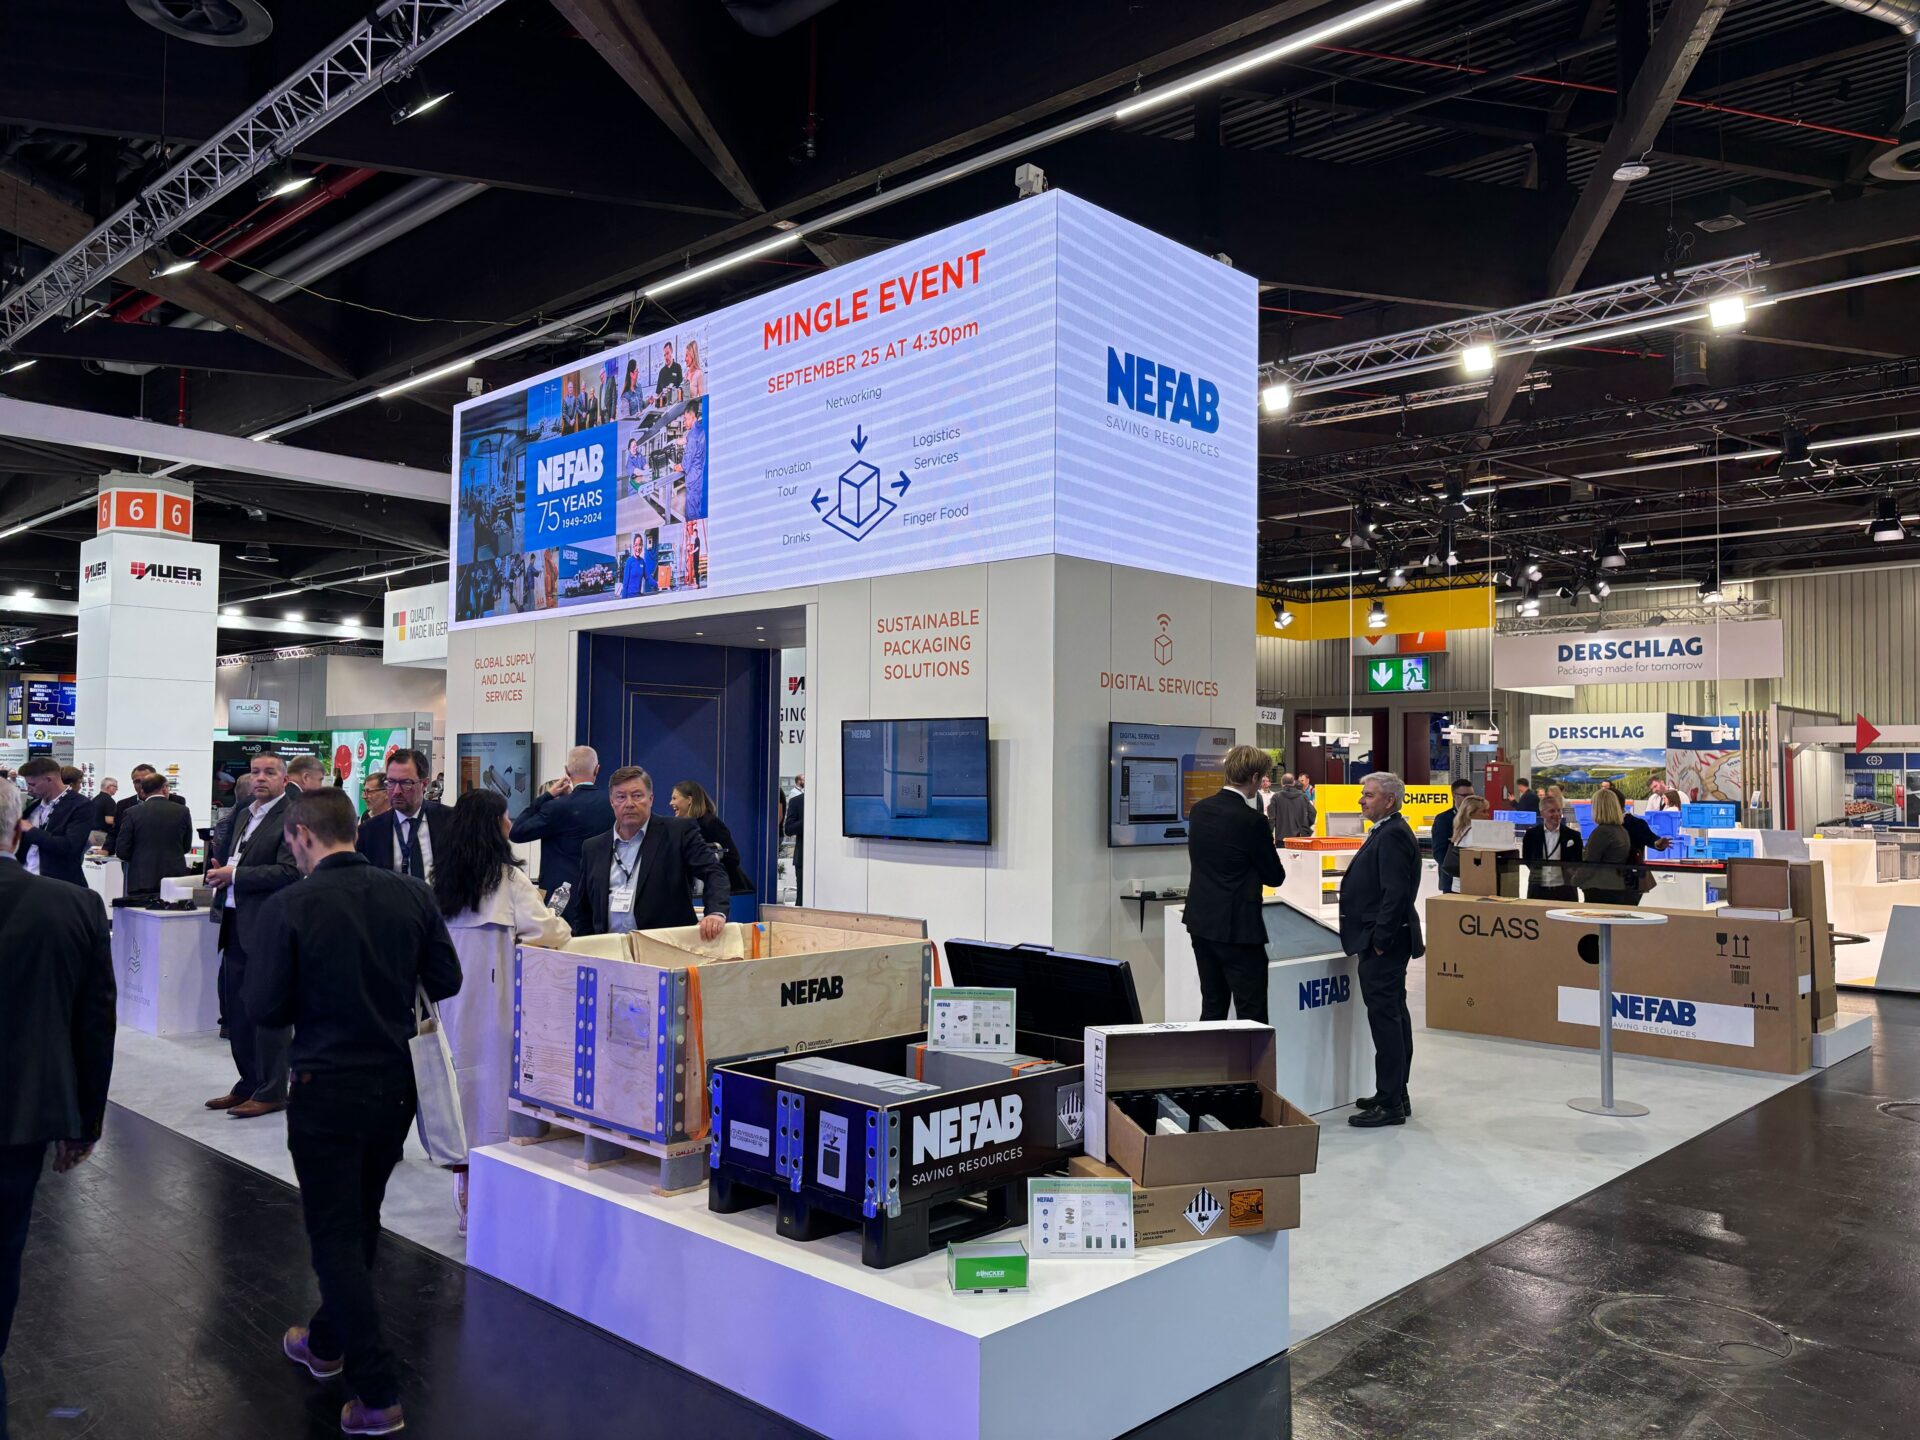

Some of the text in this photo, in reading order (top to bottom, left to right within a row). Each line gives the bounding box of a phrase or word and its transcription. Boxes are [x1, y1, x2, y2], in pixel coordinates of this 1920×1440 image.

[763, 248, 986, 350] MINGLE EVENT
[768, 320, 978, 394] SEPTEMBER 25 AT 4:30pm
[826, 386, 882, 410] Networking
[1107, 346, 1220, 434] NEFAB
[913, 428, 960, 447] Logistics
[1106, 416, 1220, 458] SAVING RESOURCES
[537, 444, 604, 495] NEFAB
[765, 460, 812, 479] Innovation
[914, 452, 958, 470] Services
[778, 485, 798, 497] Tour
[102, 500, 108, 522] 6
[129, 498, 144, 520] 6
[172, 504, 182, 526] 6
[537, 489, 602, 534] 75 YEARS
[903, 504, 969, 526] Finger Food
[562, 512, 602, 528] 1949-2024
[782, 532, 811, 545] Drinks
[136, 564, 202, 582] AUER
[150, 578, 202, 586] PACKAGING
[410, 606, 434, 623] QUALITY
[876, 609, 980, 634] SUSTAINABLE
[410, 624, 428, 640] MADE
[883, 635, 971, 656] PACKAGING
[1558, 637, 1703, 662] DERSCHLAG
[474, 652, 536, 670] GLOBAL SUPPLY
[884, 660, 970, 680] SOLUTIONS
[1558, 662, 1703, 677] Packaging made for tomorrow
[482, 672, 526, 686] AND LOCAL
[1100, 672, 1218, 697] DIGITAL SERVICES
[486, 690, 523, 702] SERVICES
[1262, 710, 1276, 720] 6-228
[851, 728, 872, 739] NEFAB
[1120, 732, 1136, 740] DIGITAL
[1549, 726, 1644, 740] DERSCHLAG
[1402, 793, 1448, 804] CHÄFER
[1458, 914, 1540, 940] GLASS
[781, 976, 844, 1008] NEFAB
[1299, 974, 1350, 1010] NEFAB
[1612, 994, 1696, 1026] NEFAB
[1612, 1022, 1697, 1038] AVING RESOURCES
[912, 1094, 1022, 1166] NEFAB
[912, 1147, 1022, 1186] SAVING RESOURCES
